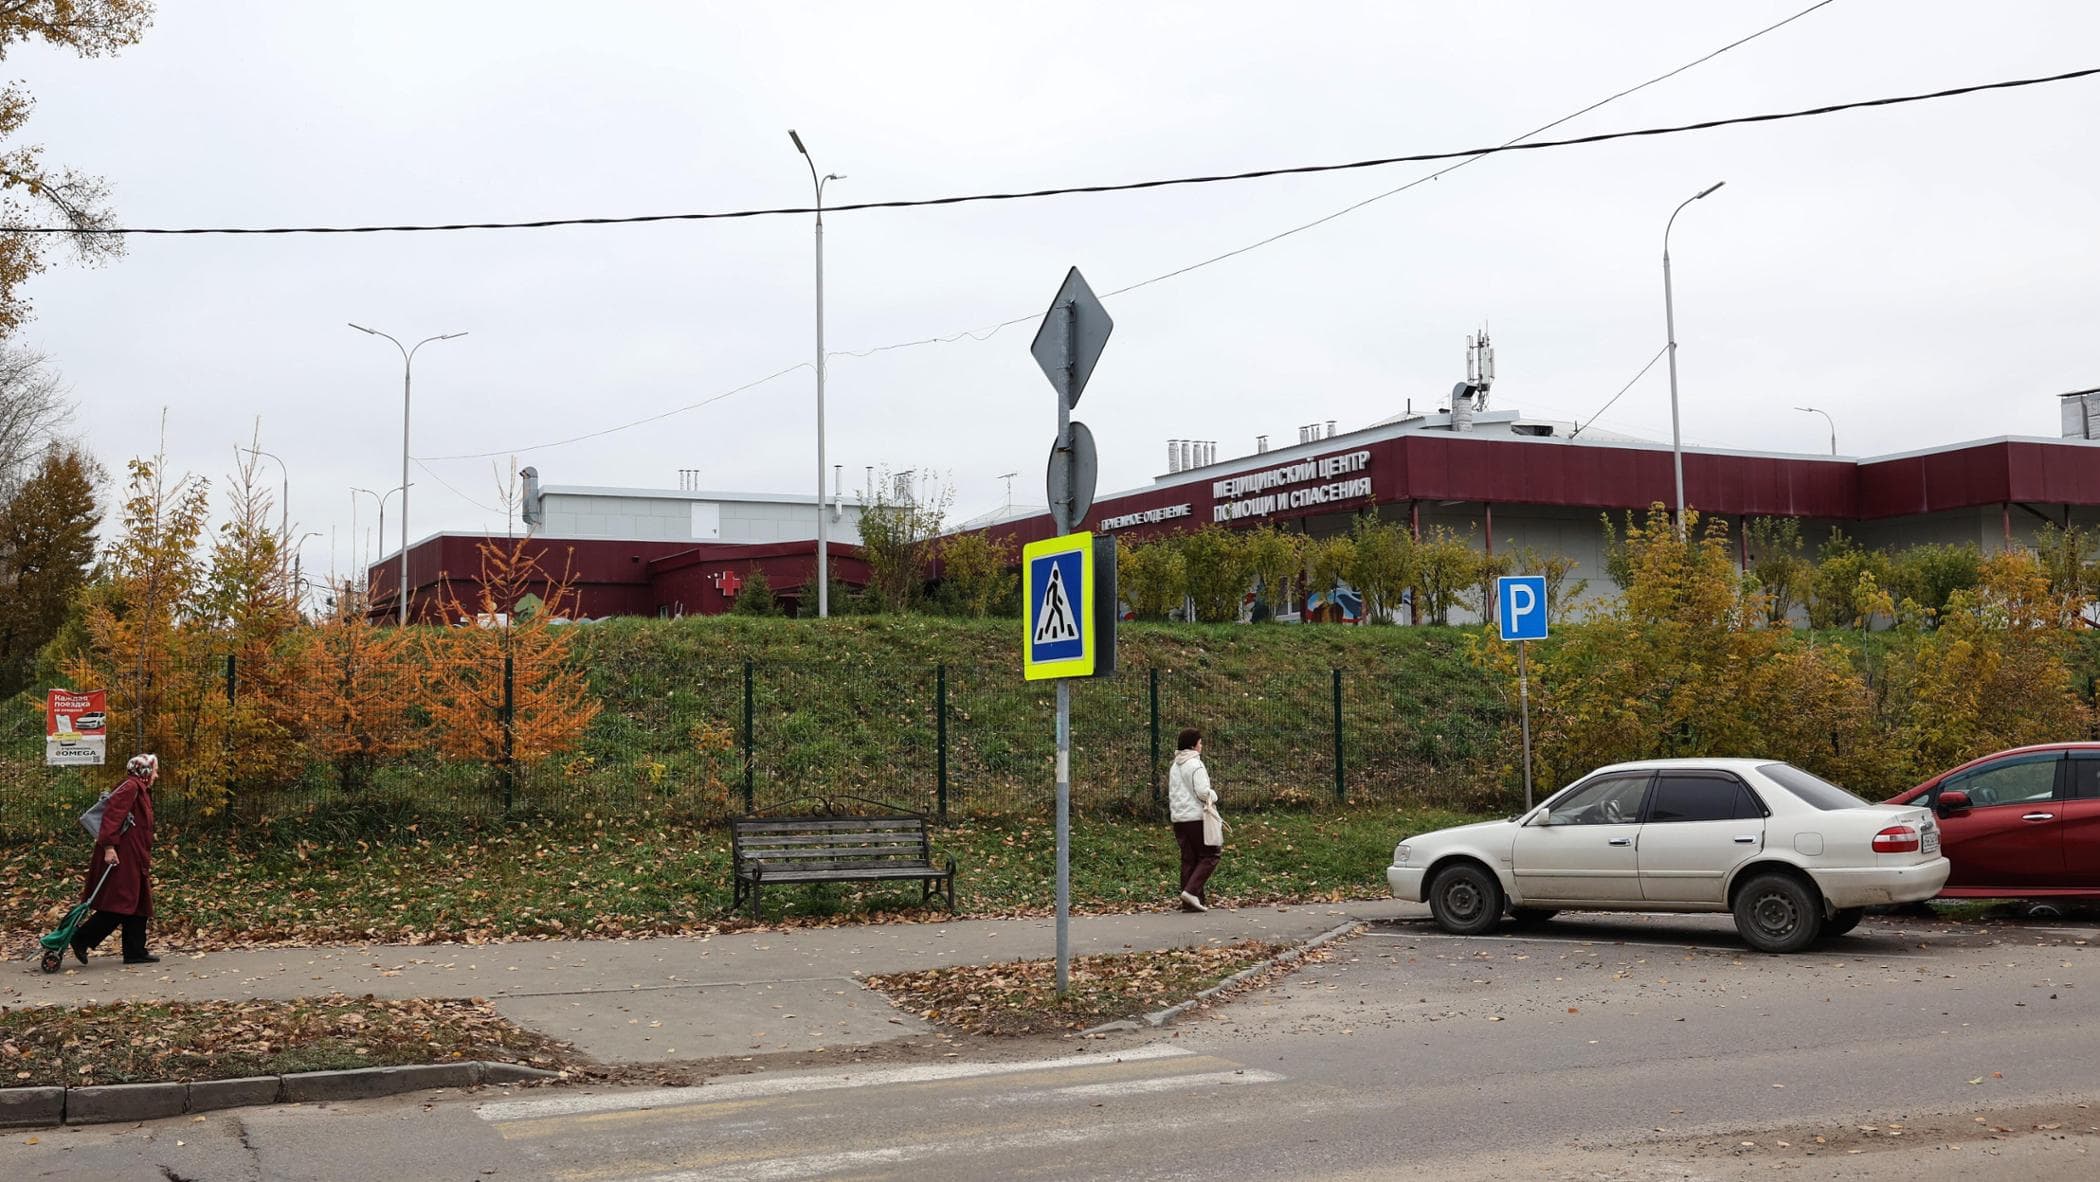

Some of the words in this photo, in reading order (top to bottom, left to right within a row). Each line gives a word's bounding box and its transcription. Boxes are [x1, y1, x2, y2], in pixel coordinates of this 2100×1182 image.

[1213, 457, 1317, 498] МЕДИЦИНСКИЙ
[1318, 451, 1371, 479] ЦЕНТР
[1101, 512, 1144, 531] ПРИЕМНОЕ
[1144, 503, 1192, 524] ОТДЕЛЕНИЕ
[1213, 494, 1276, 522] ПОМОЩИ
[1277, 491, 1289, 511] И
[1290, 477, 1372, 508] СПАСЕНИЯ
[1510, 584, 1535, 633] P
[54, 694, 88, 702] Каждая
